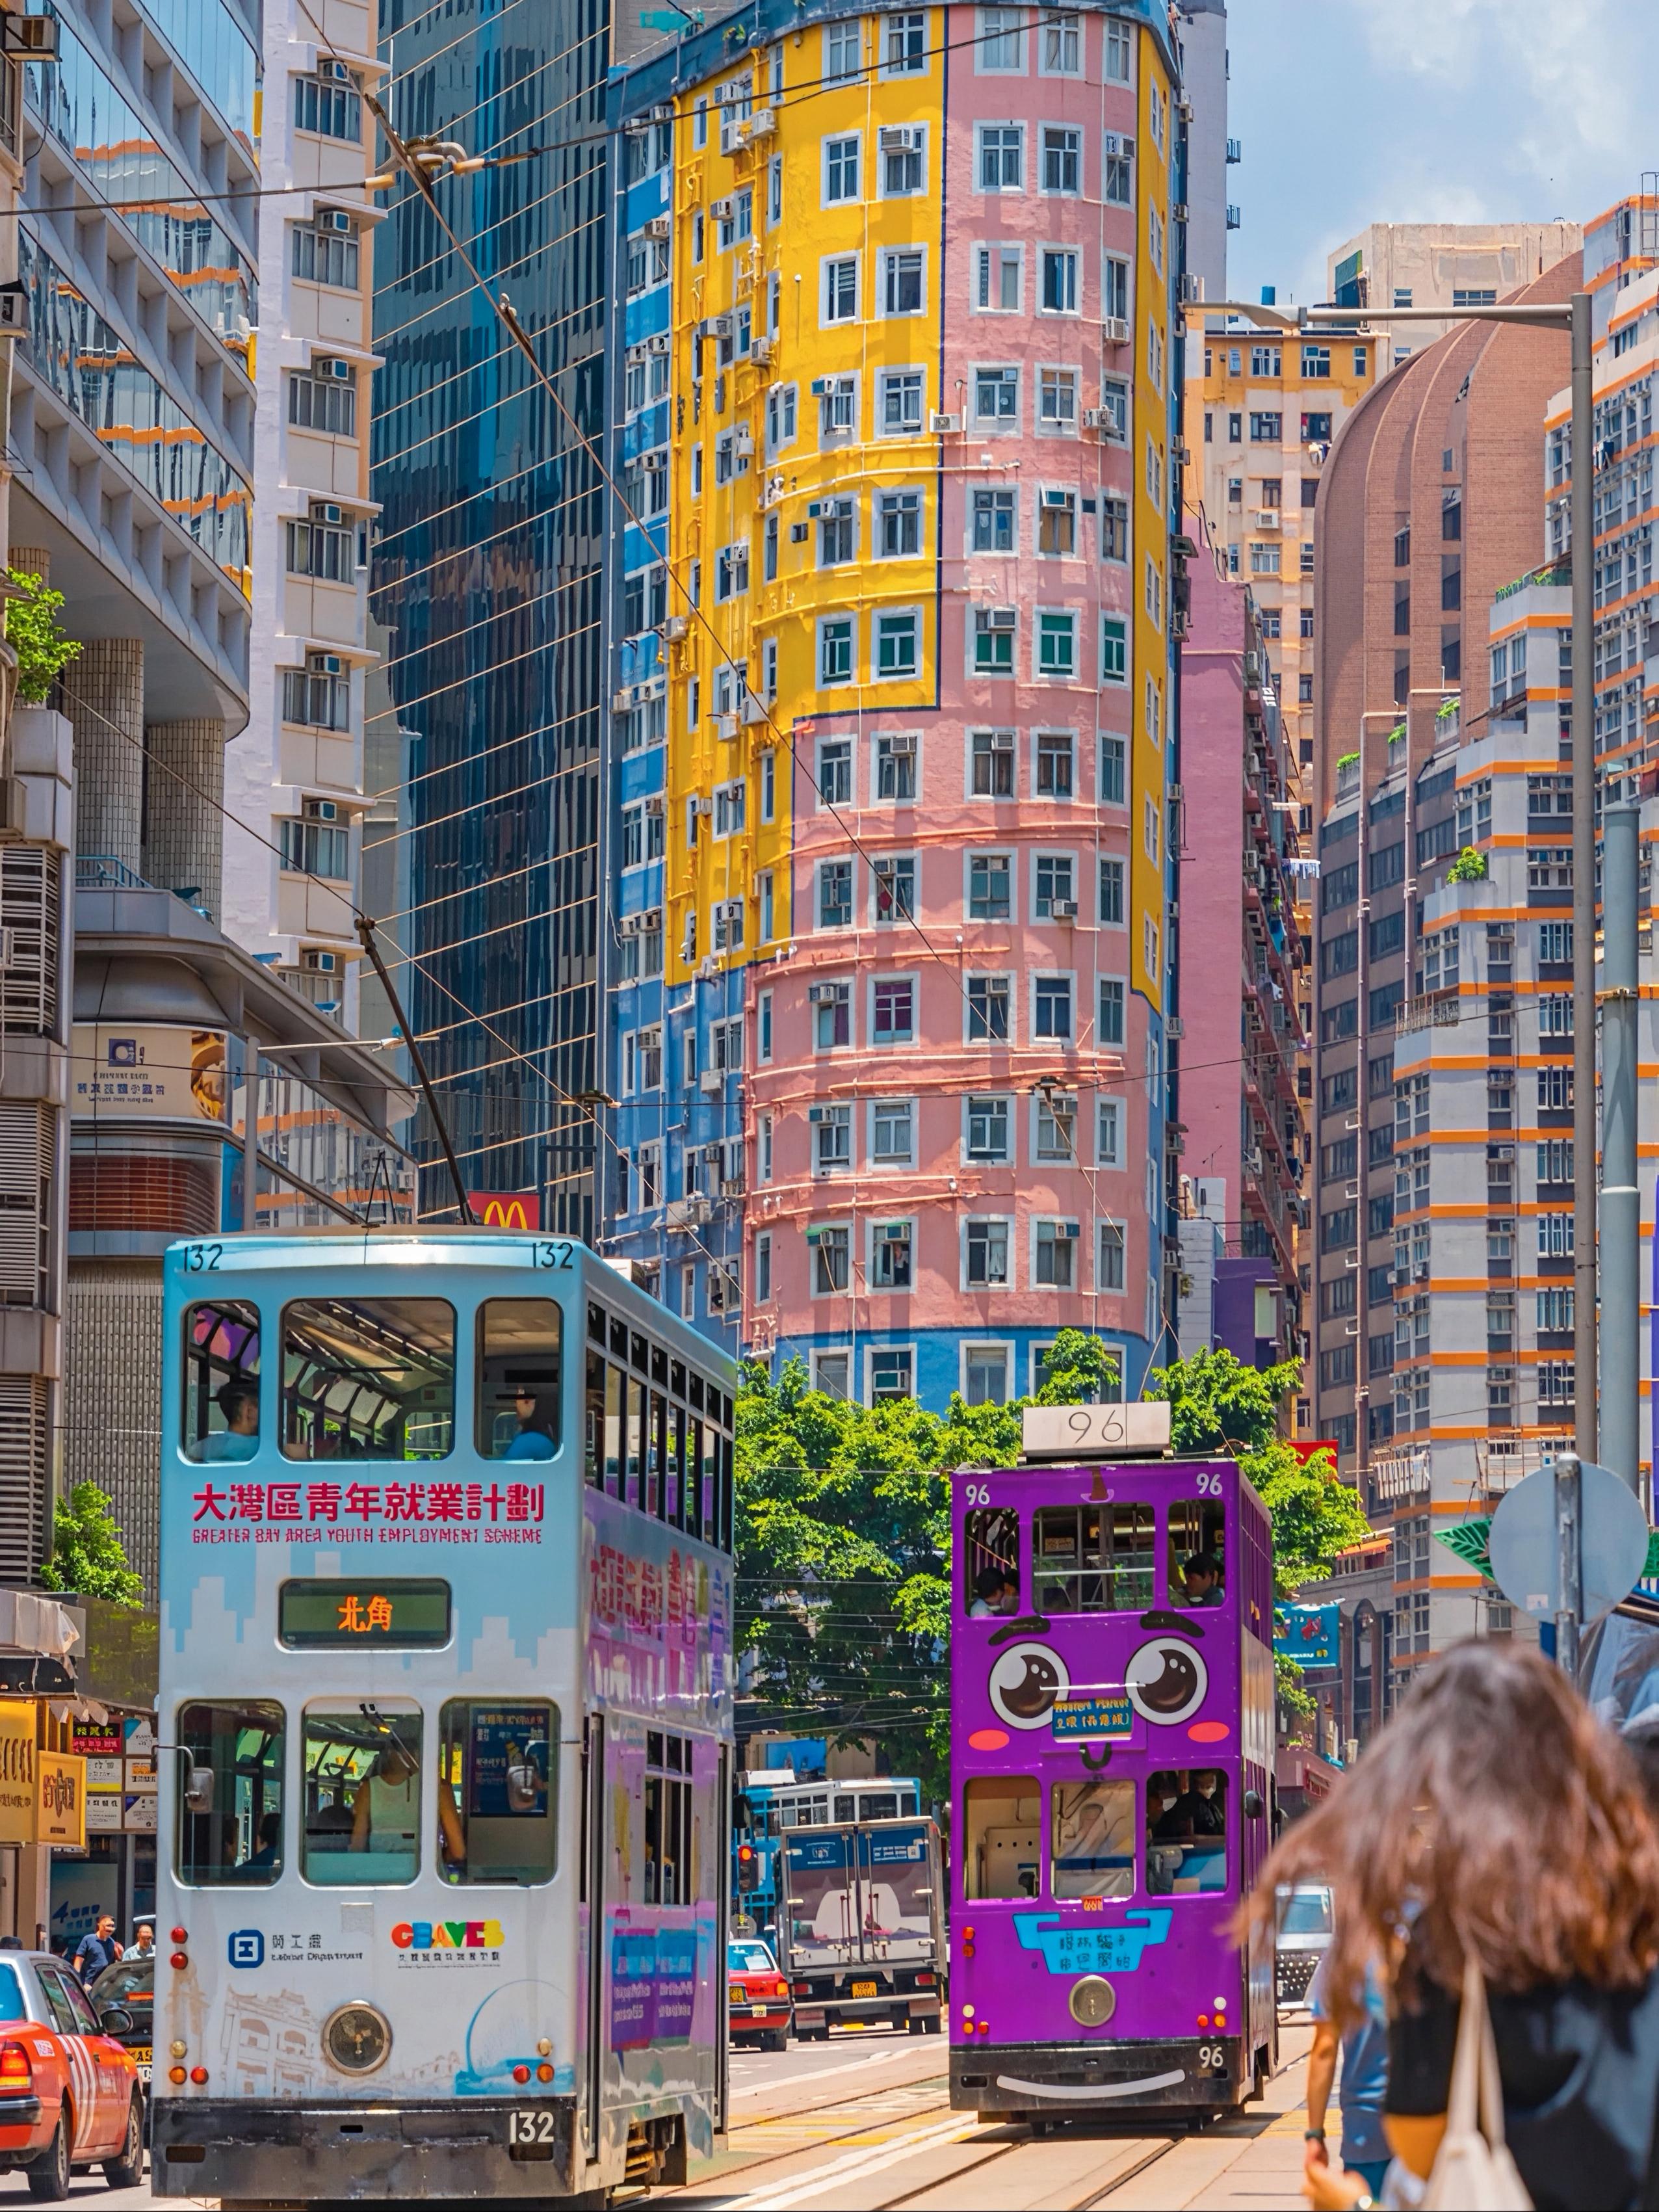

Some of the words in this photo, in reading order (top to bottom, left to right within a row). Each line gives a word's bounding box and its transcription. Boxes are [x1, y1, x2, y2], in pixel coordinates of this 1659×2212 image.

[183, 1244, 223, 1271] 132
[532, 1242, 573, 1269] 132
[1068, 1409, 1124, 1444] 96
[965, 1484, 990, 1506] 96
[1196, 1473, 1223, 1495] 96
[192, 1482, 544, 1522] 大灣區青年就業計劃
[285, 1528, 322, 1543] AREA
[327, 1528, 373, 1544] YOUTH
[378, 1528, 478, 1544] EMPLOYMENT
[484, 1528, 542, 1544] SCHEME
[337, 1596, 393, 1632] 北角
[1198, 2046, 1224, 2068] 96
[509, 2111, 555, 2144] 132
